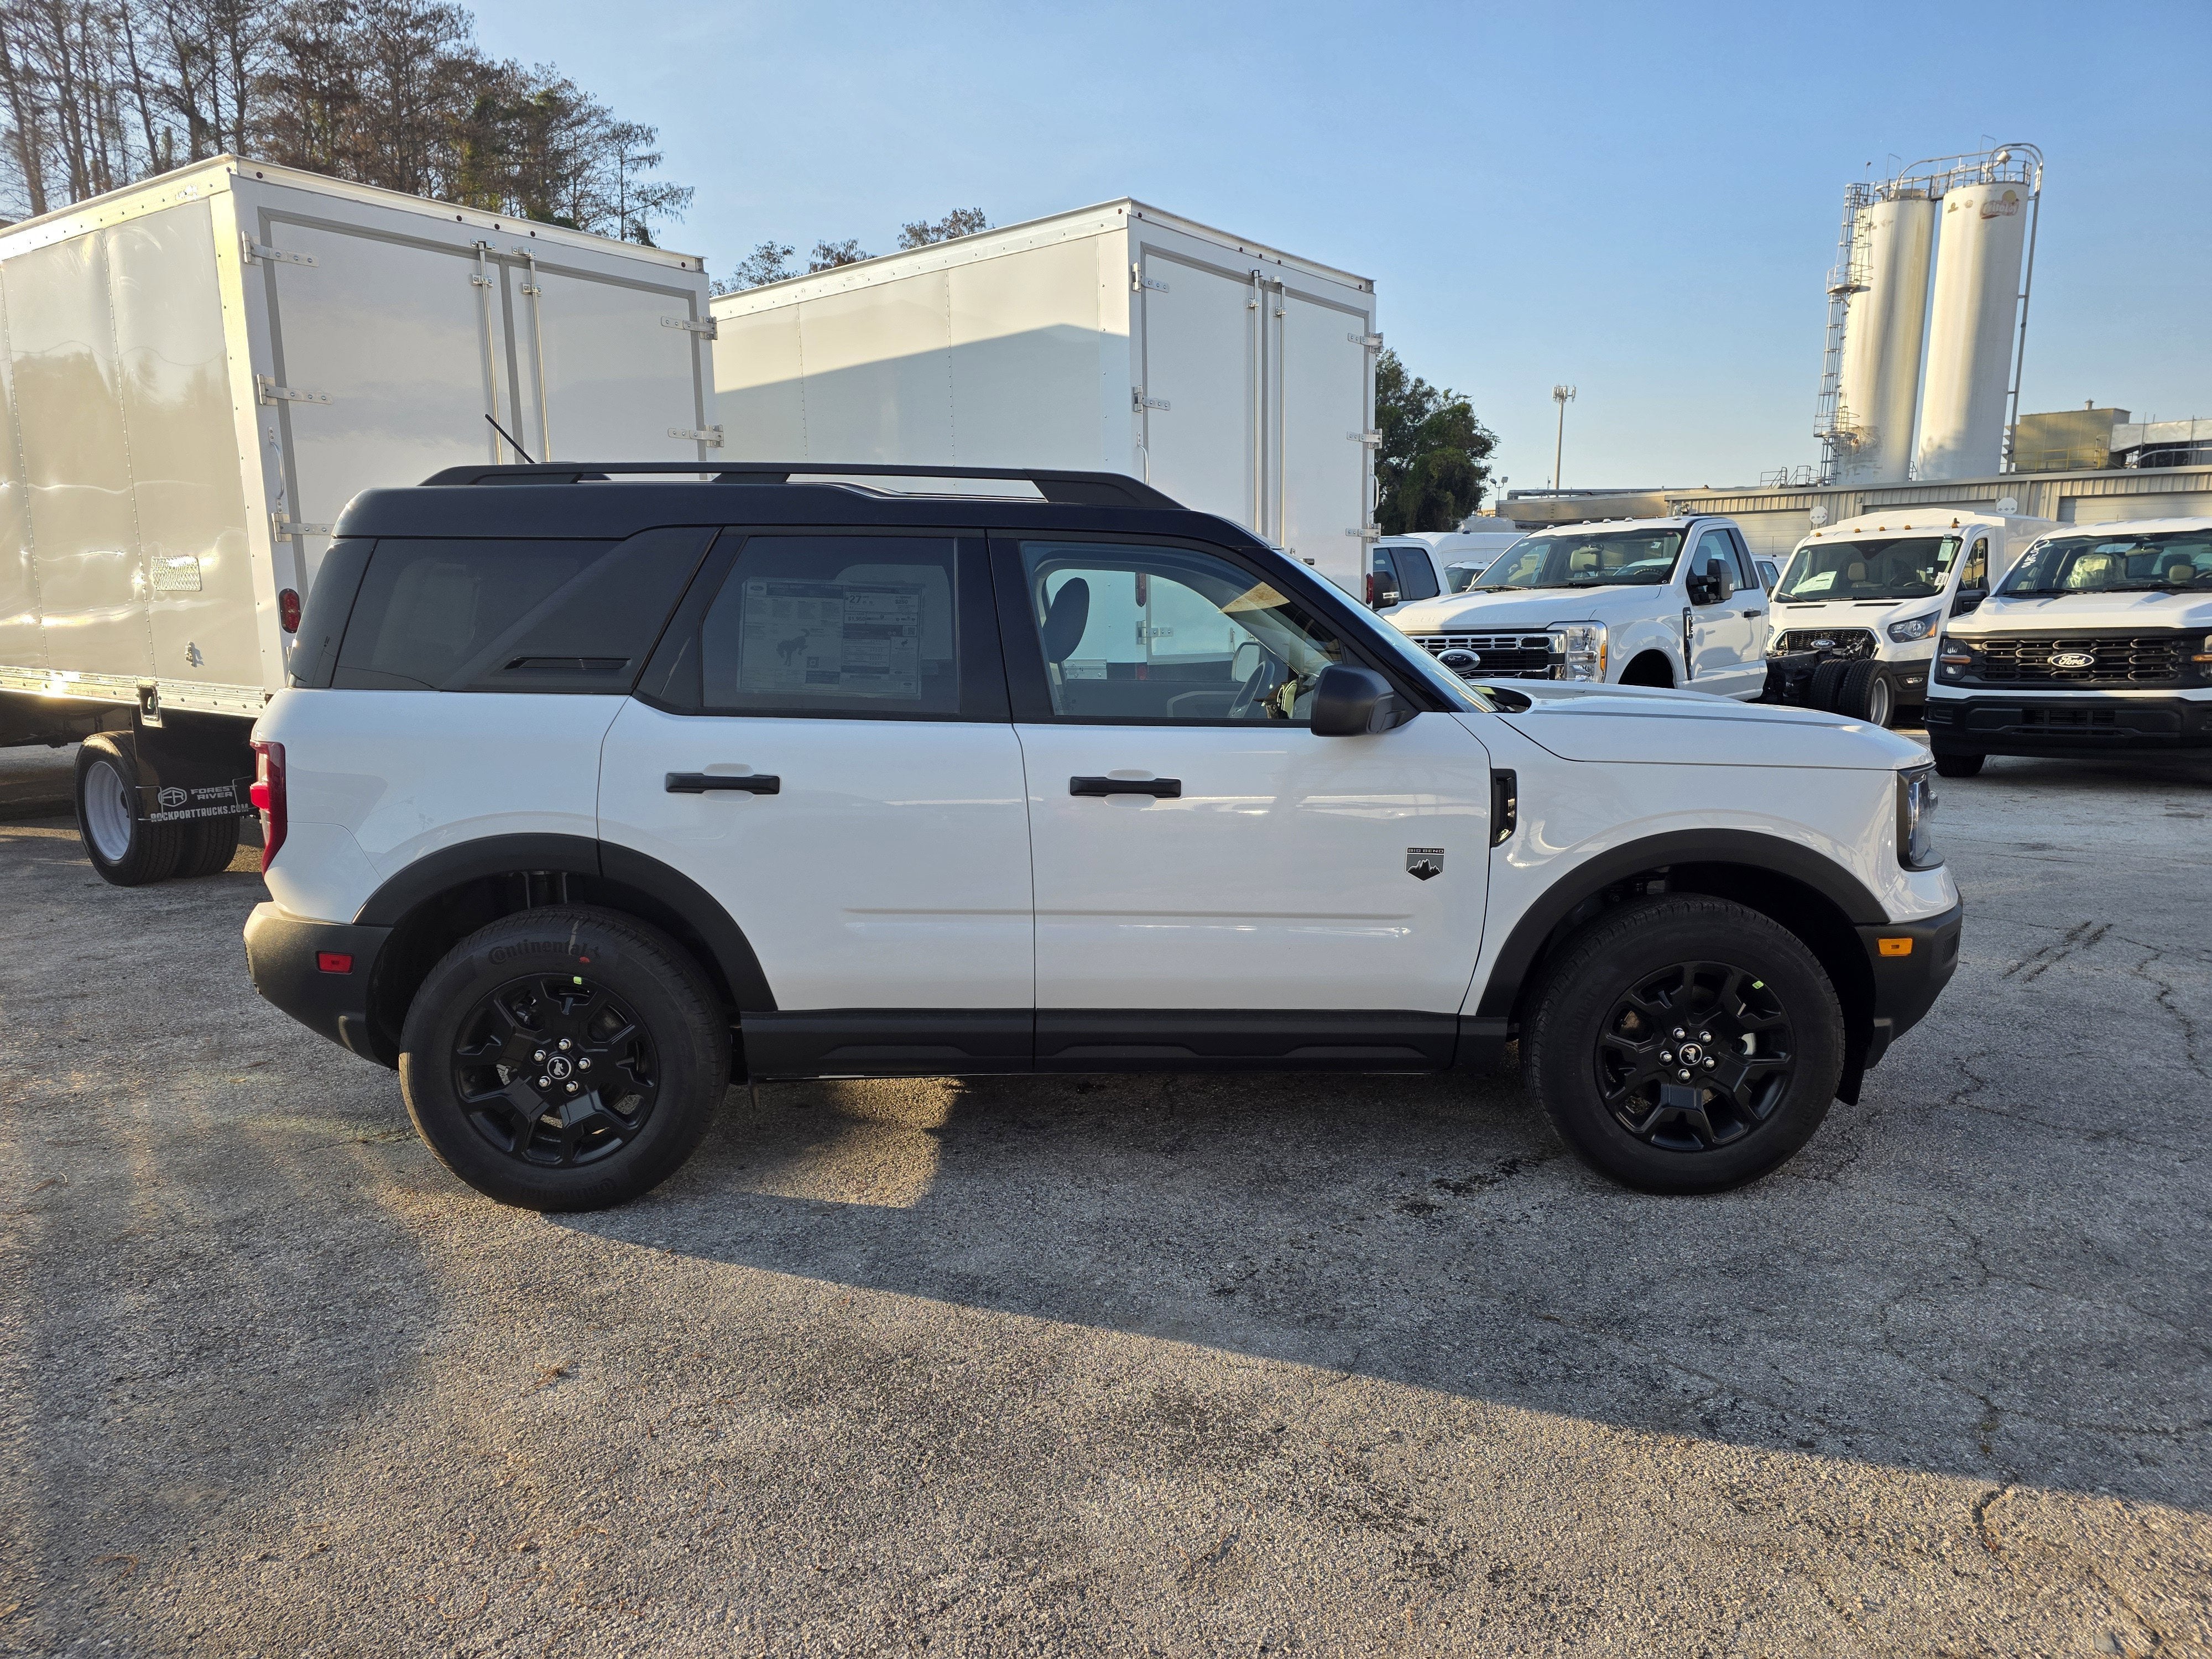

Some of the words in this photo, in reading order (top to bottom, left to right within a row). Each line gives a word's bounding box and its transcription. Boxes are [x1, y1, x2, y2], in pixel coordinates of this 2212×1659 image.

[849, 595, 862, 603] 27
[2058, 655, 2086, 665] Ford
[190, 785, 237, 795] FOREST
[196, 791, 233, 800] RIVER
[150, 803, 249, 823] ROCKPORTTRUCKS.COM
[488, 938, 588, 966] Continental
